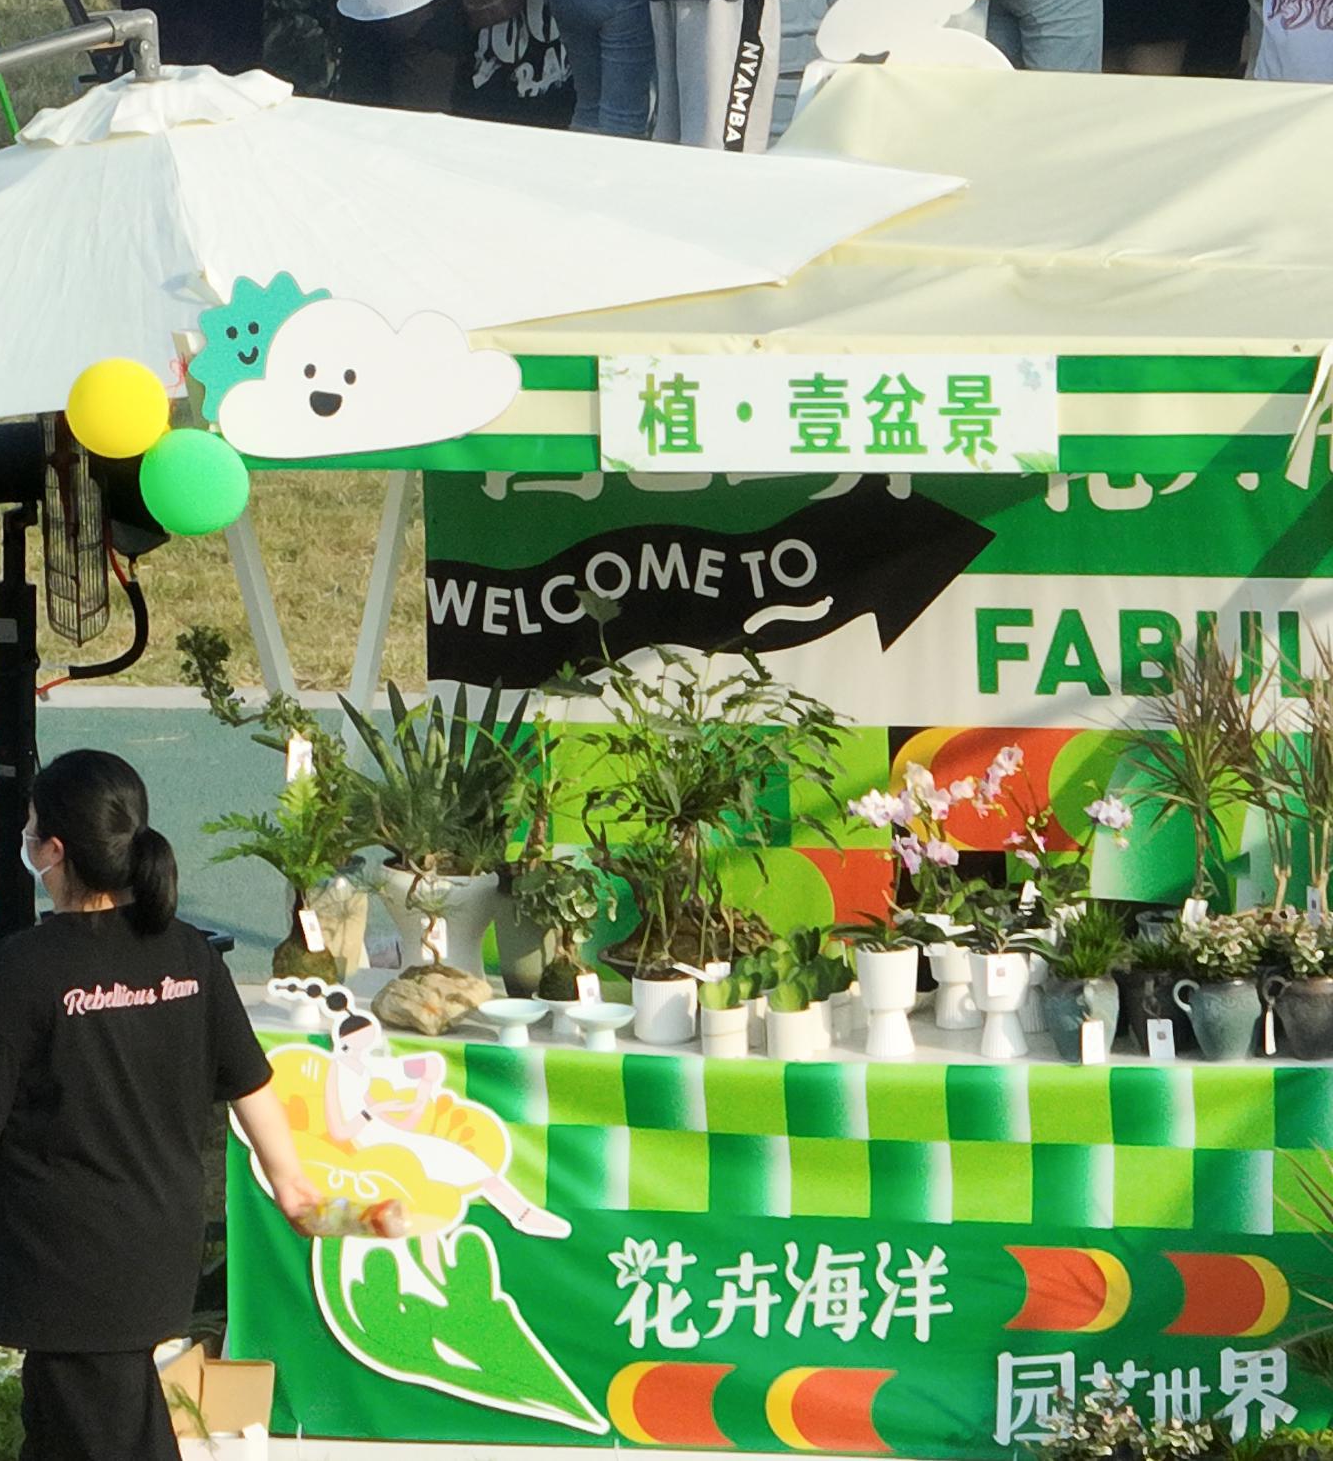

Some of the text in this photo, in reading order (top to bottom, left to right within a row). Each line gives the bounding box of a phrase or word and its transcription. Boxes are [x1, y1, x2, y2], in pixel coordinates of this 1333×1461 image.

[724, 40, 761, 143] NYAMBA
[637, 372, 1002, 458] 植·壹盆景
[426, 538, 818, 636] WELCOME TO
[63, 982, 158, 1016] Rebellious
[606, 1237, 954, 1349] 花卉海洋
